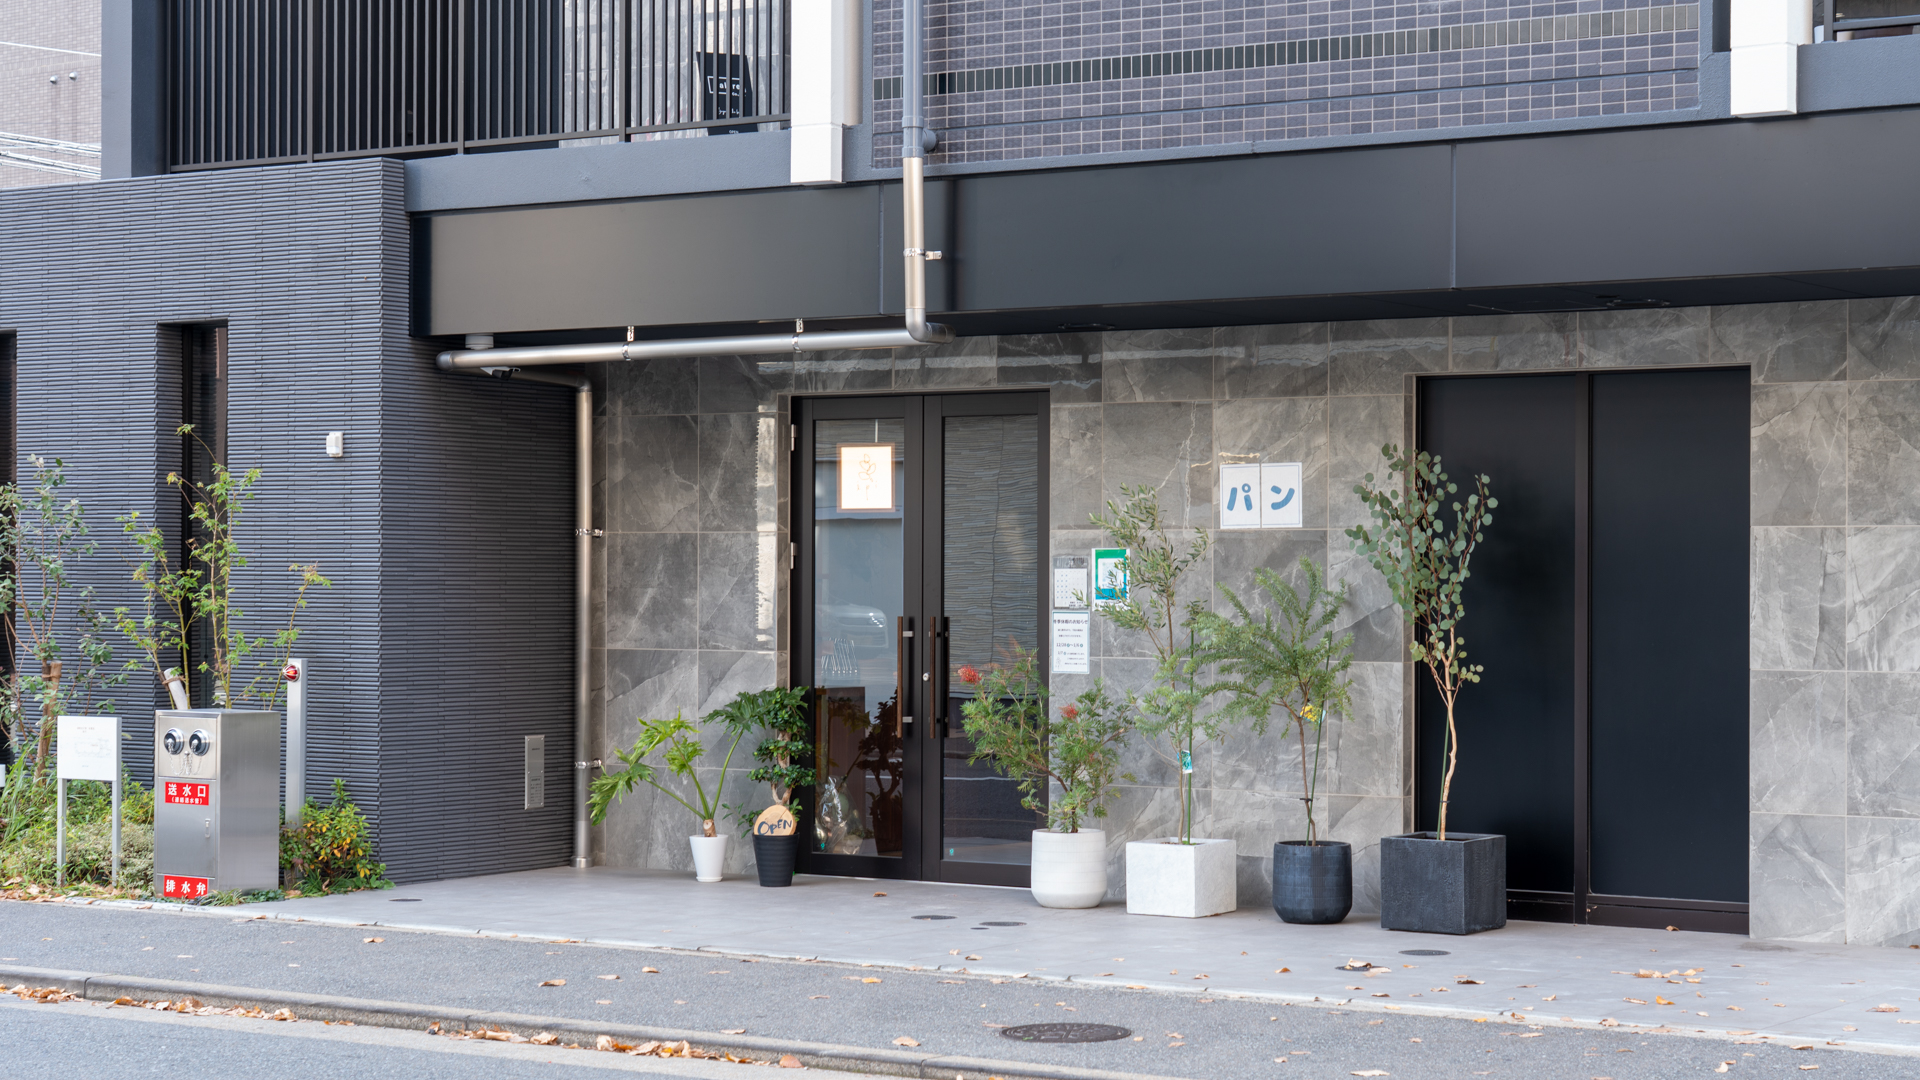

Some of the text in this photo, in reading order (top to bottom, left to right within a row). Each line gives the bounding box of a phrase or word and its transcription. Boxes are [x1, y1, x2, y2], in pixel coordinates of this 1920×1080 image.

[1227, 483, 1295, 511] パン
[168, 783, 206, 797] 送水口
[757, 819, 792, 835] OPEN
[166, 879, 206, 895] 排水弁
